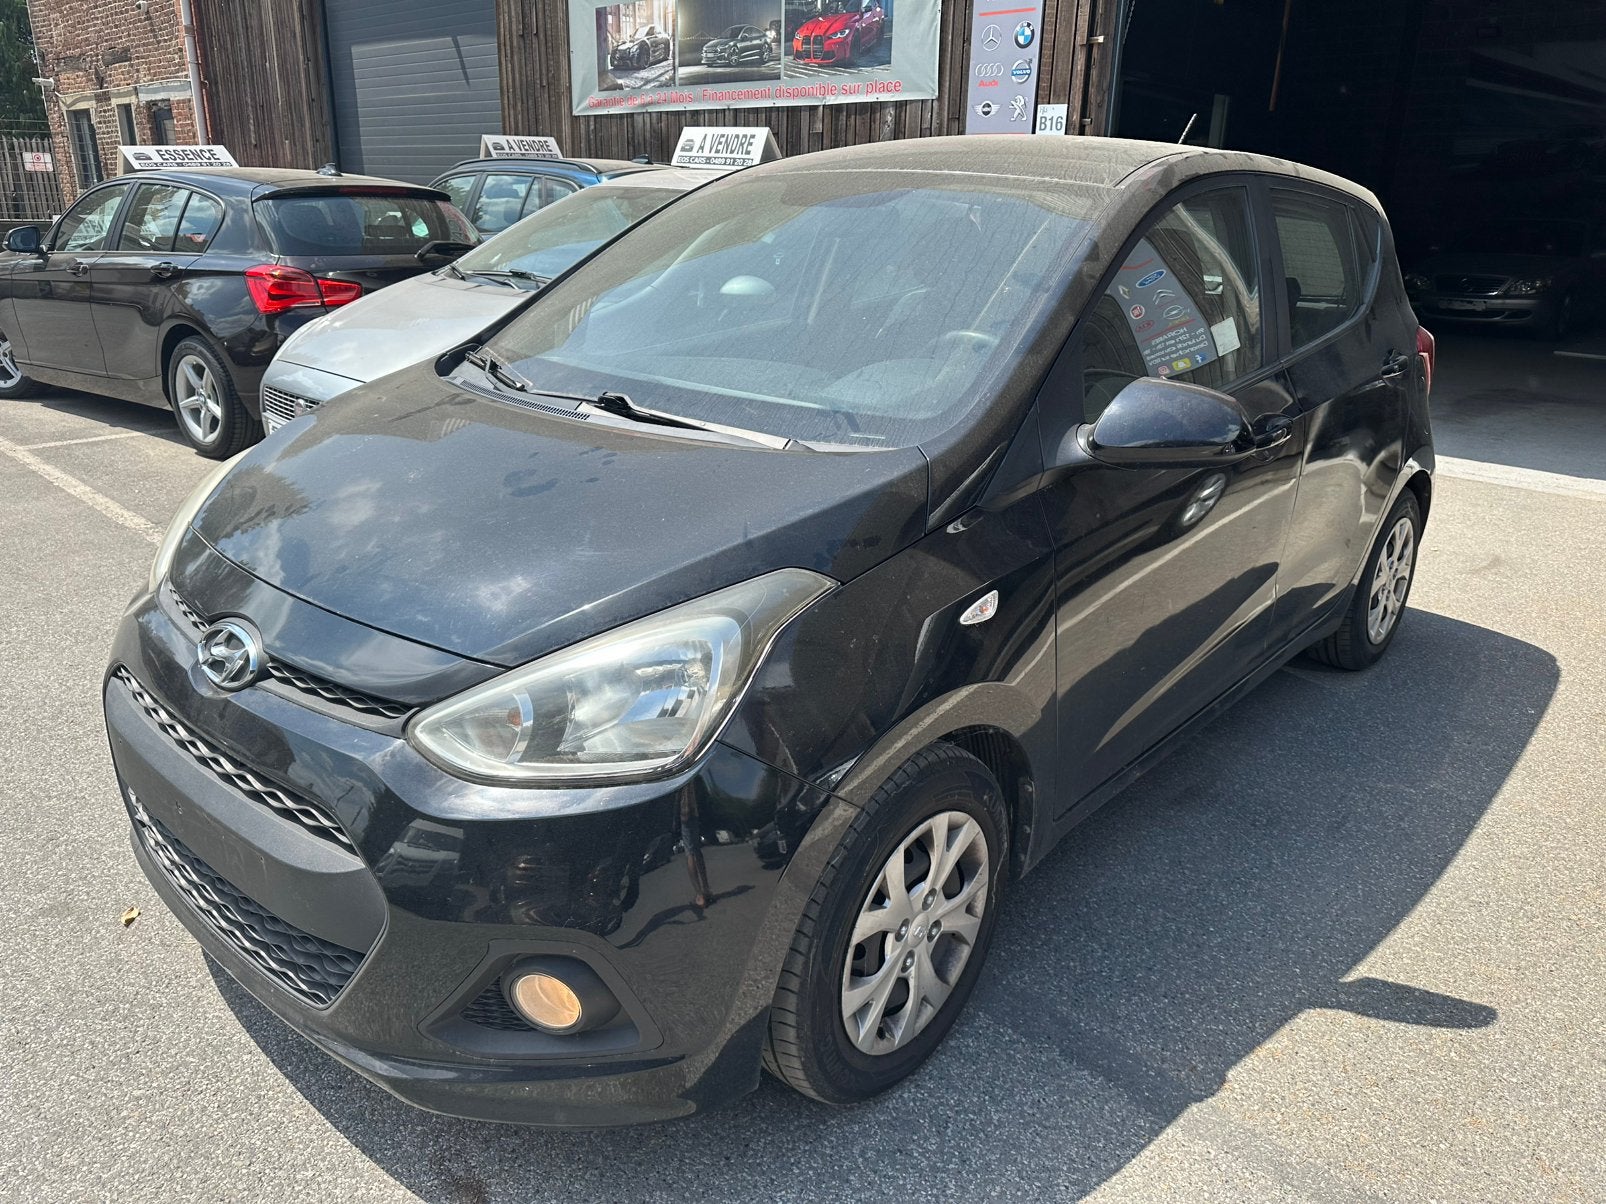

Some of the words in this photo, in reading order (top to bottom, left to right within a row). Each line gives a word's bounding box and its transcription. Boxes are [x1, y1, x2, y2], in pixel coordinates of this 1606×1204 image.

[588, 96, 624, 108] Garantie
[627, 95, 638, 106] de
[640, 93, 645, 104] 6
[656, 92, 667, 104] 24
[670, 90, 693, 104] Mois
[702, 85, 771, 101] Financement
[774, 83, 837, 100] disponible
[841, 83, 862, 95] sur
[866, 79, 902, 96] place
[1039, 116, 1063, 131] B16
[506, 139, 516, 152] A
[513, 139, 553, 152] VENDRE
[697, 133, 707, 153] A
[709, 133, 756, 155] VENDRE
[155, 149, 221, 161] ESSENCE
[690, 156, 706, 164] CARS
